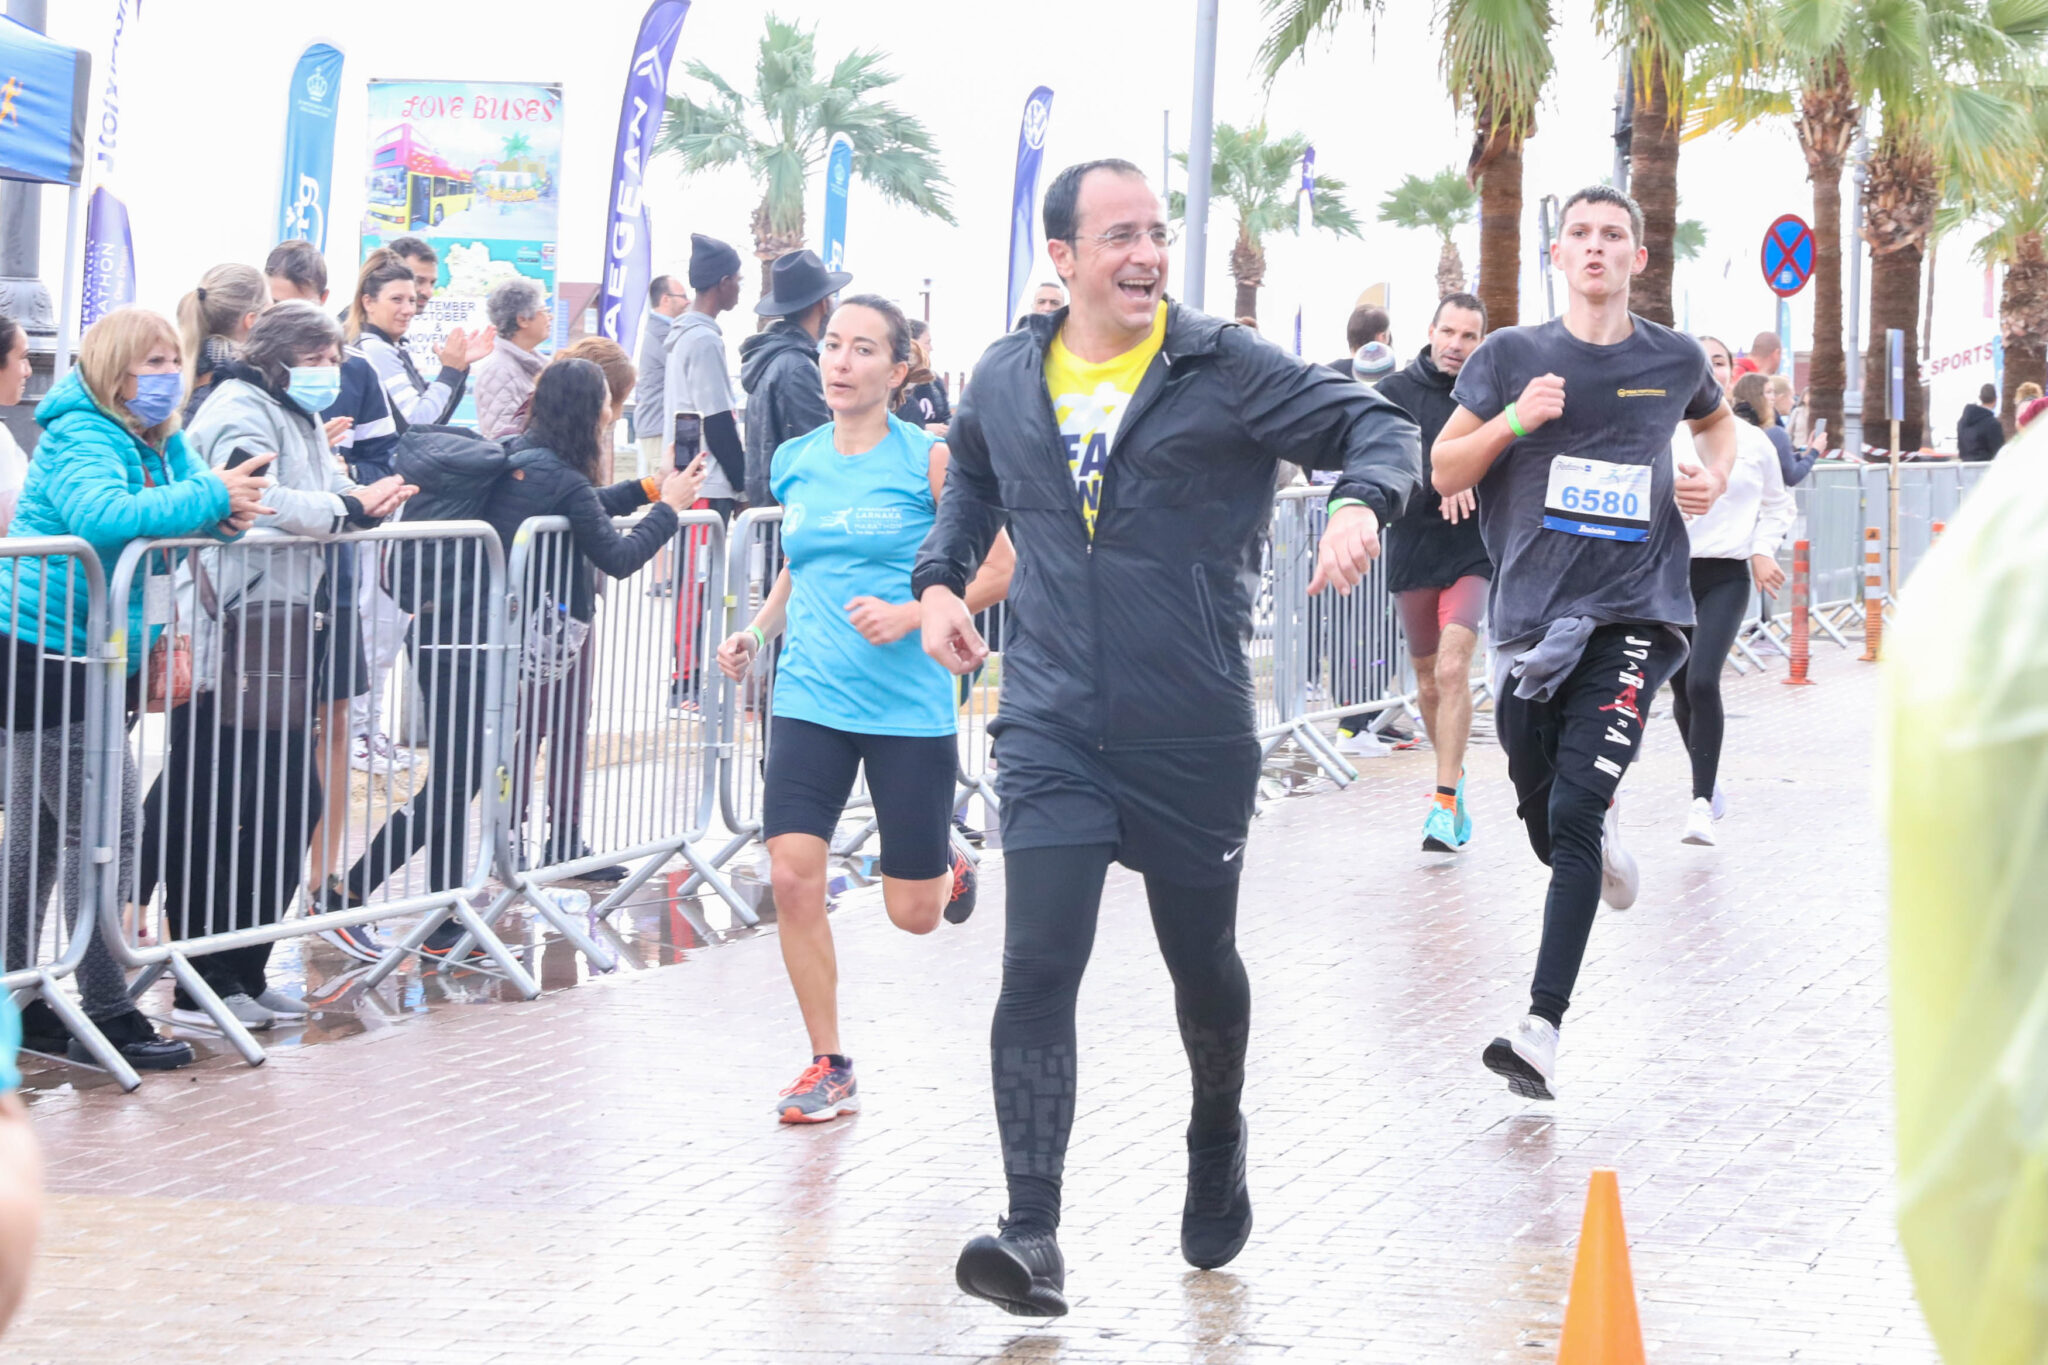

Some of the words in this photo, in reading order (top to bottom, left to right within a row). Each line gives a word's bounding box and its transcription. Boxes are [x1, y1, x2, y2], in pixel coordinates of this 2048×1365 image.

[401, 95, 465, 120] LOVE
[473, 95, 557, 122] BUSES
[603, 95, 649, 341] AEGEAN
[428, 301, 476, 312] TEMBER
[1930, 342, 1993, 376] SPORTS
[1561, 486, 1638, 517] 6580
